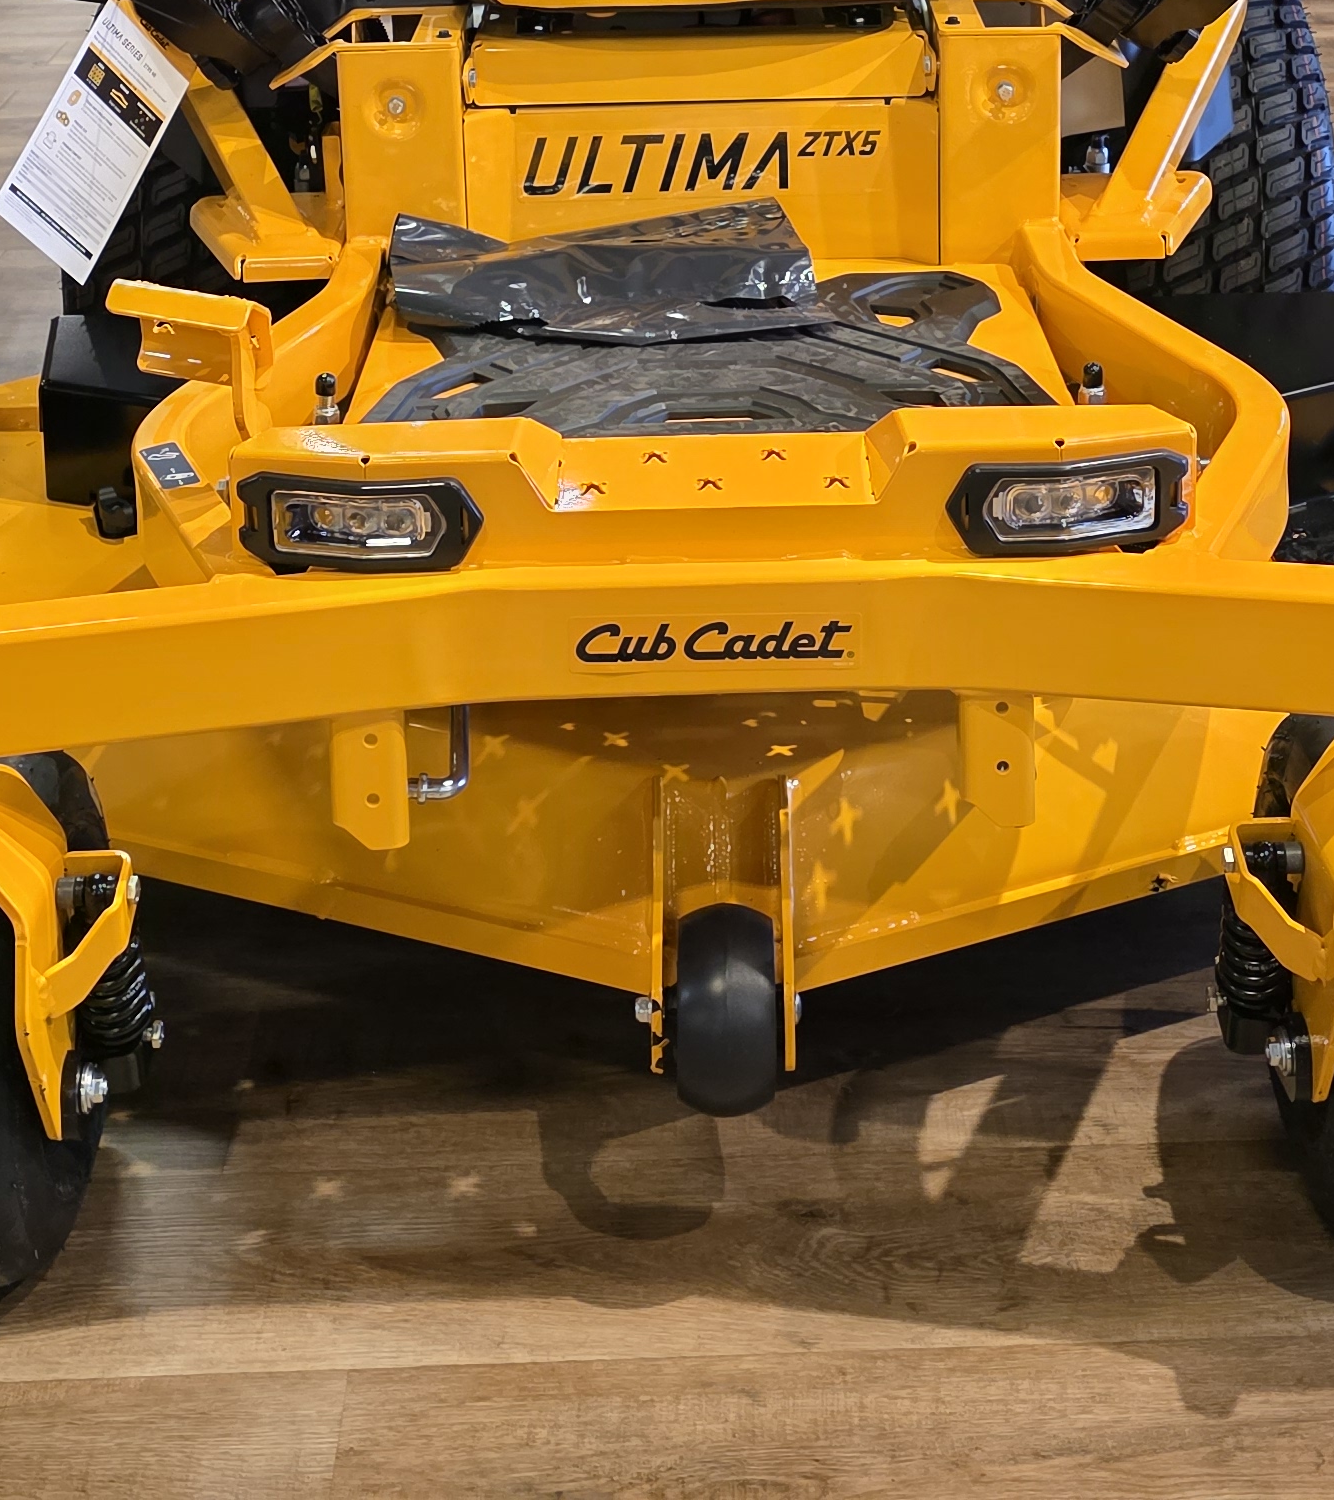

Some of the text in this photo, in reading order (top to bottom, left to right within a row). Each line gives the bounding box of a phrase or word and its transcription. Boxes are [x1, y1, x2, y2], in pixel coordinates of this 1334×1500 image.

[101, 17, 124, 42] ULTIMA
[121, 38, 144, 62] SERIES
[523, 130, 881, 195] ULTIMA ZTX5
[576, 621, 853, 663] Cub Cadet
